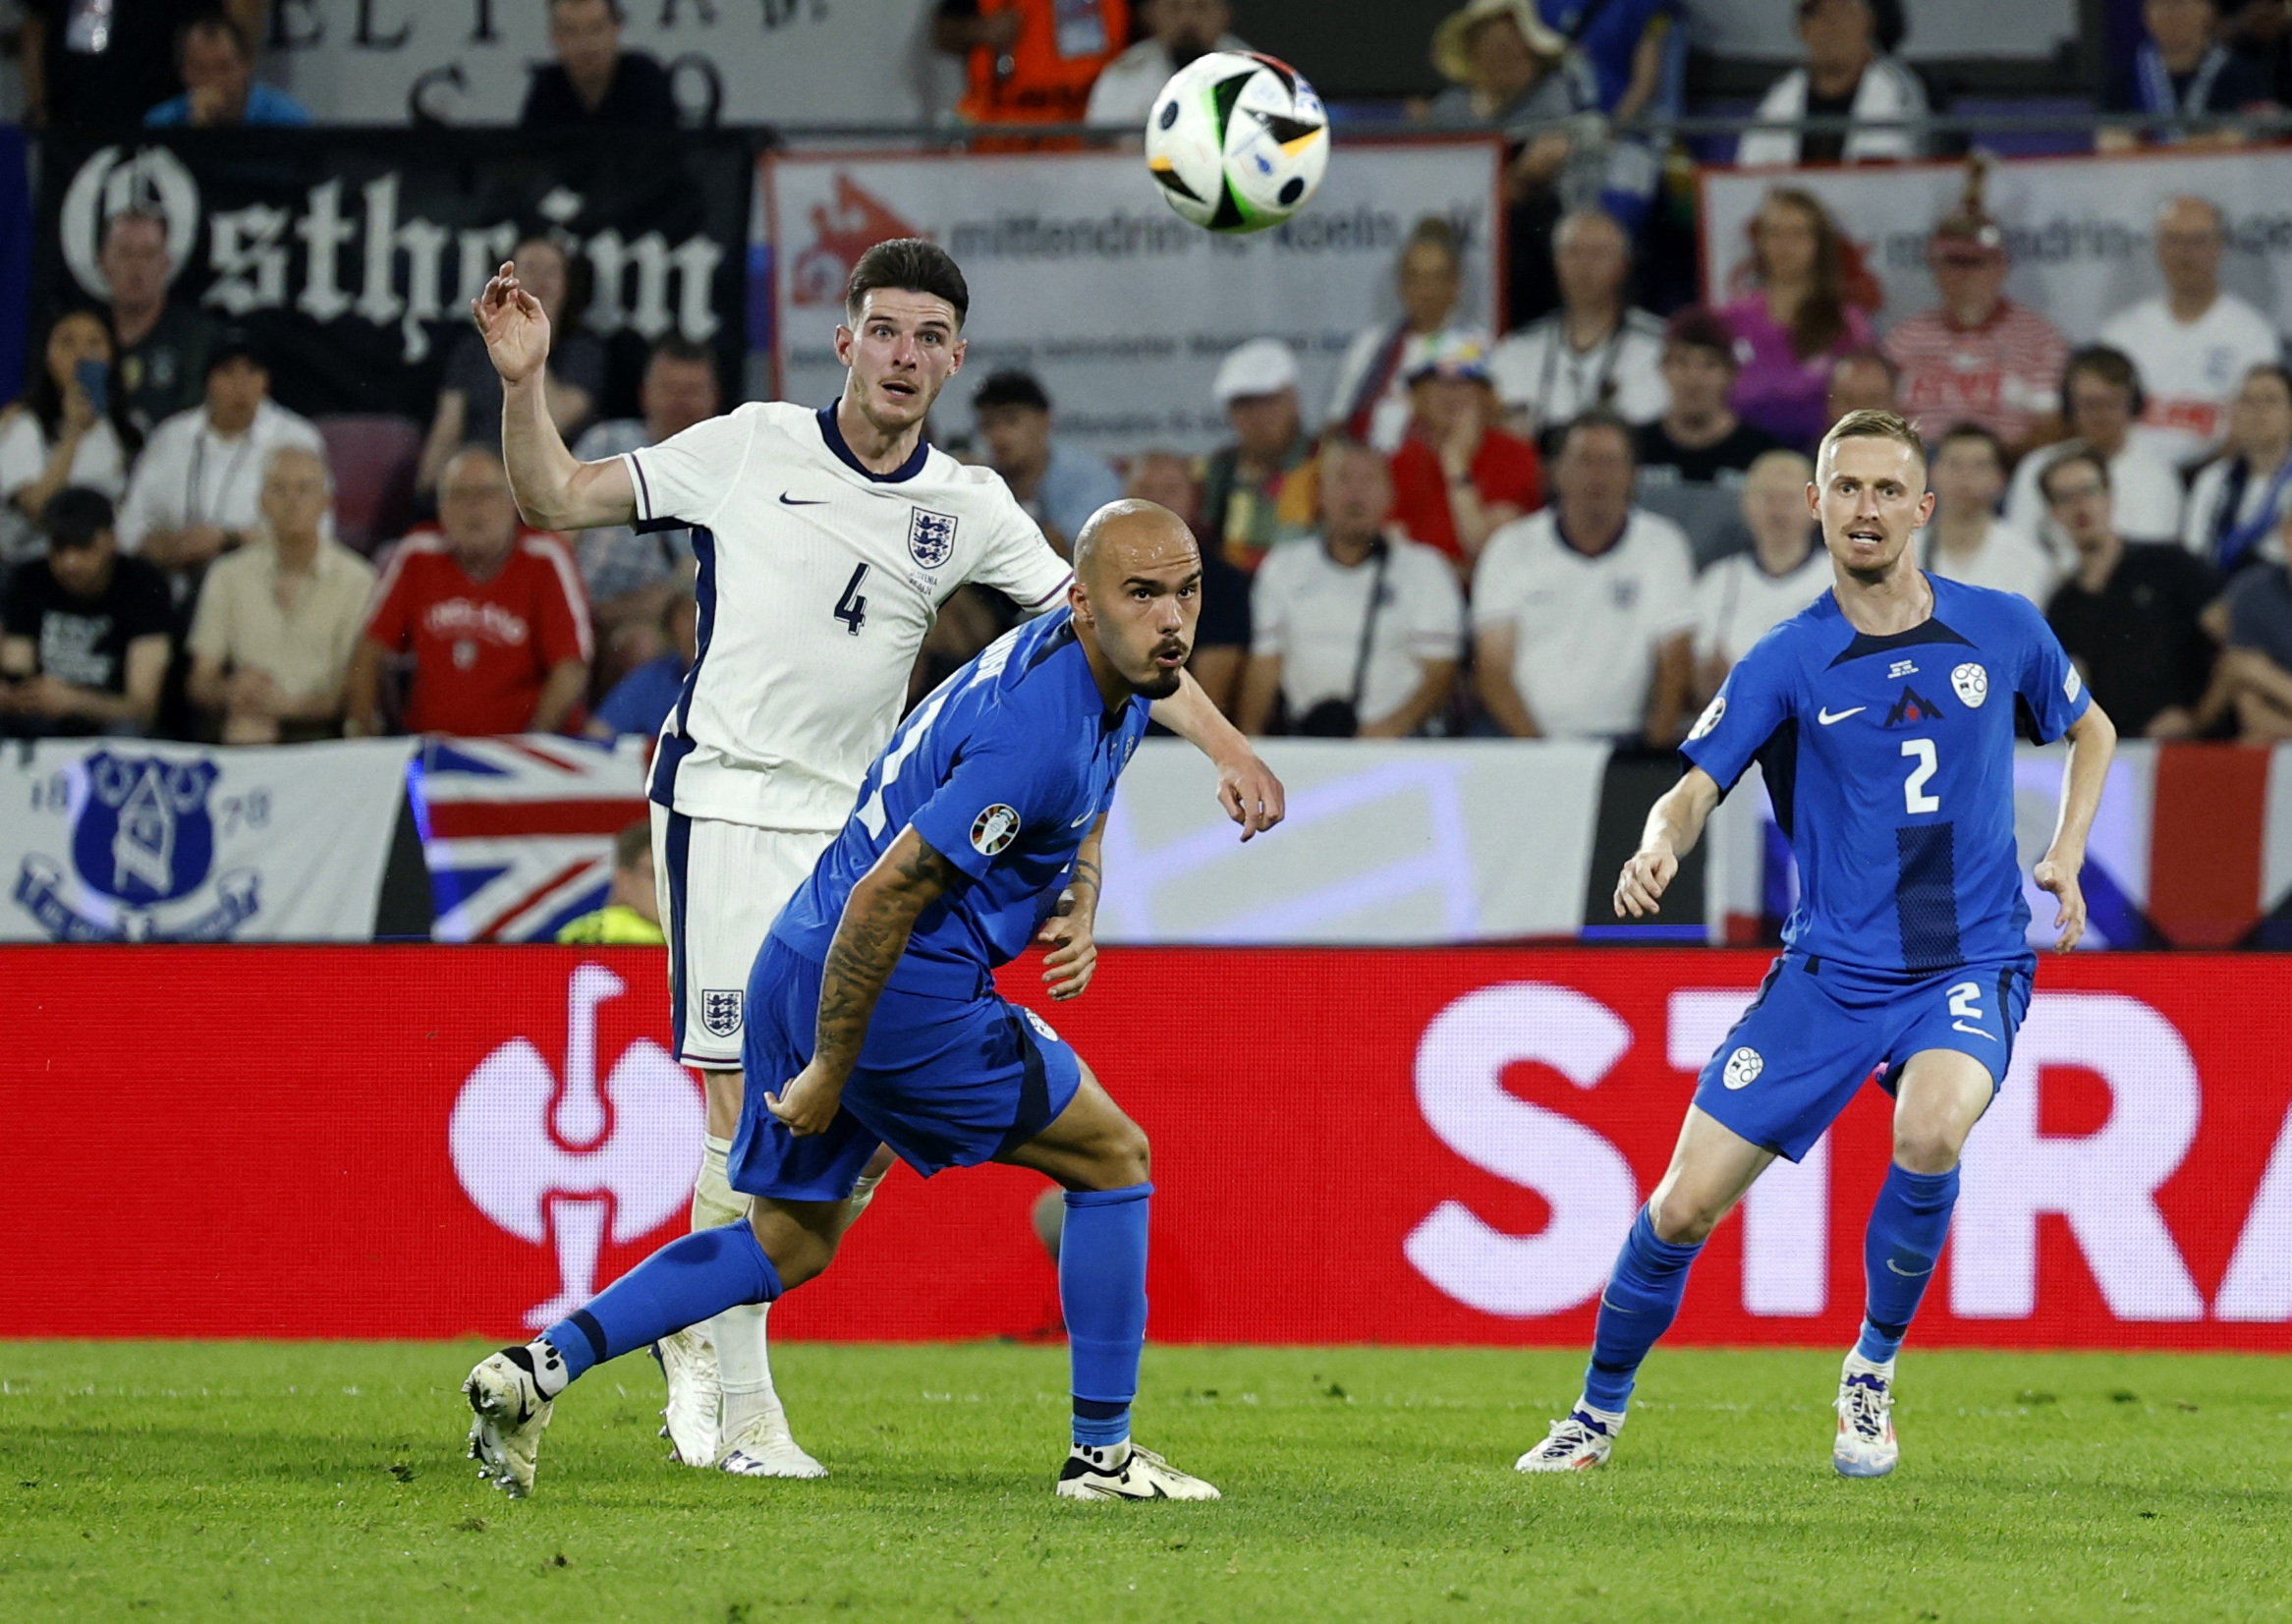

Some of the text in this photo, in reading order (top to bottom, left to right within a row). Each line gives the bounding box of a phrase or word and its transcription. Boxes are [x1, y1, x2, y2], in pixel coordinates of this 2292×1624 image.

[833, 561, 870, 637] 4
[1900, 737, 1940, 814] 2
[1945, 980, 1984, 1020] 2
